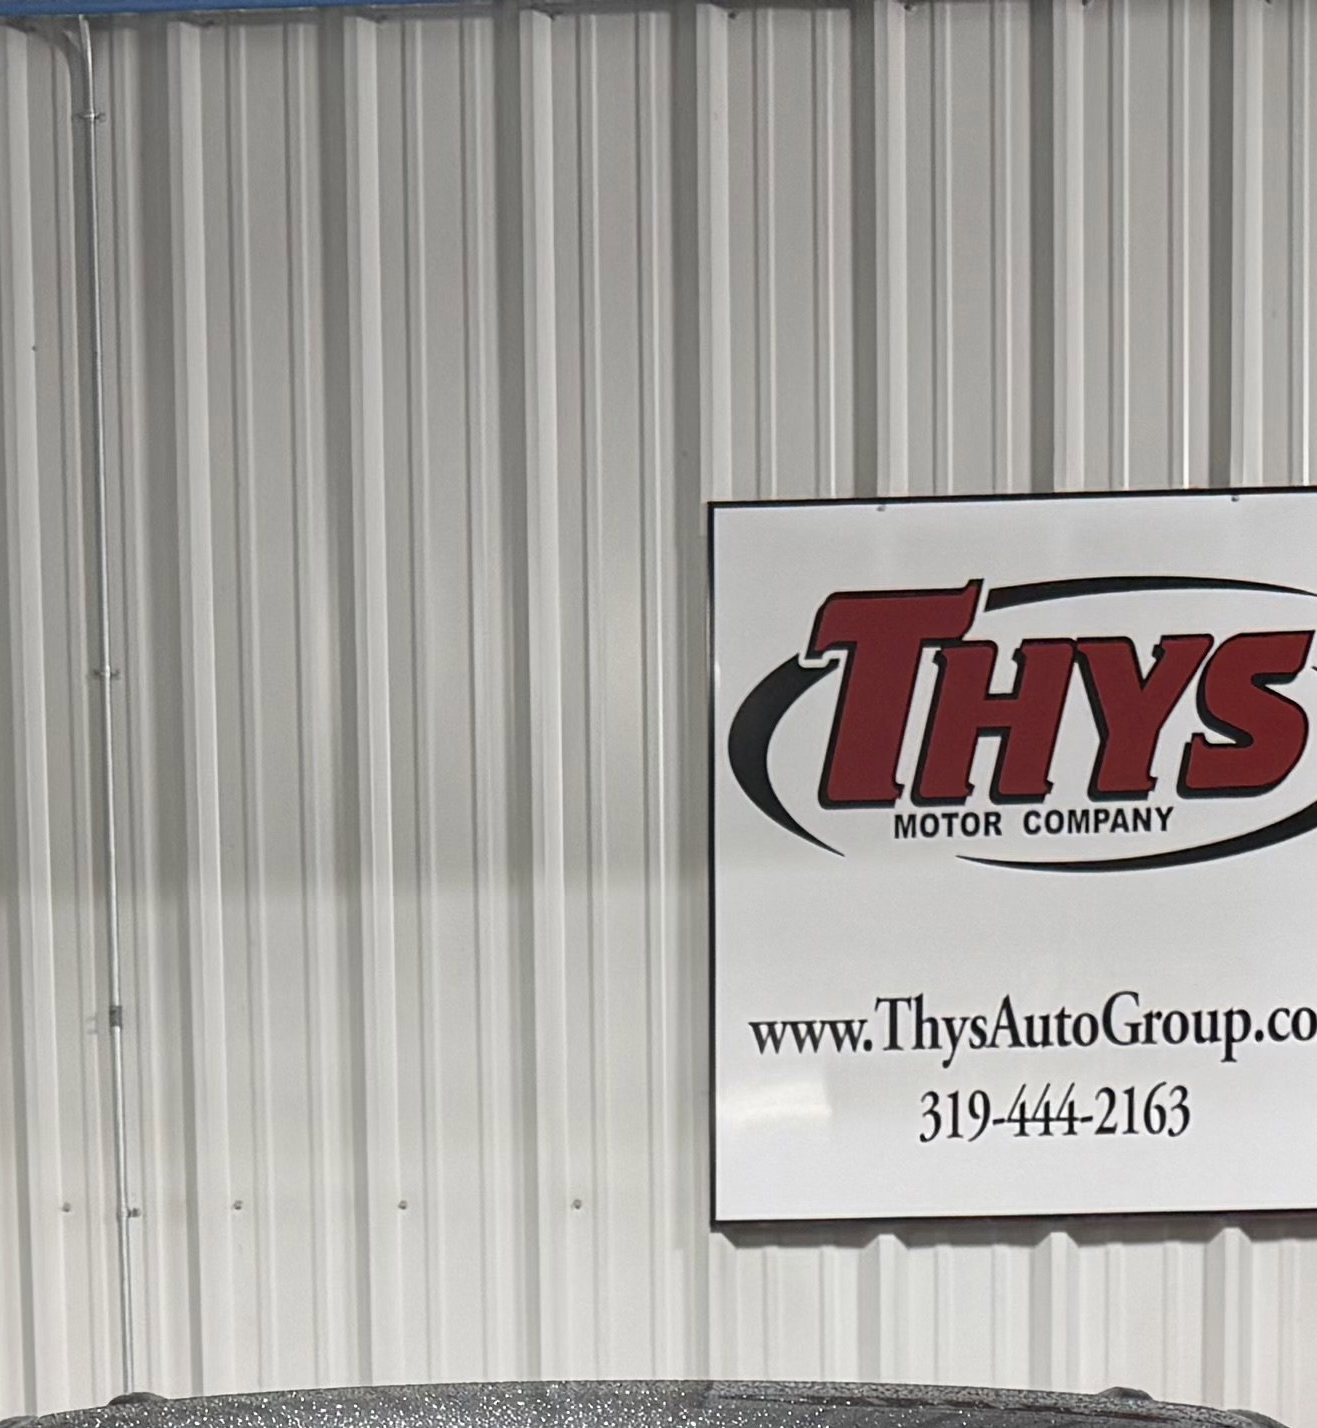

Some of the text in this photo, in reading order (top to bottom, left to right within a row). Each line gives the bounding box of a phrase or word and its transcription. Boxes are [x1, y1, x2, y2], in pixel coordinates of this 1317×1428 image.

[805, 577, 1316, 809] THYS
[894, 806, 1174, 839] MOTOR COMPANY
[919, 1081, 1191, 1144] 319-444-2163
